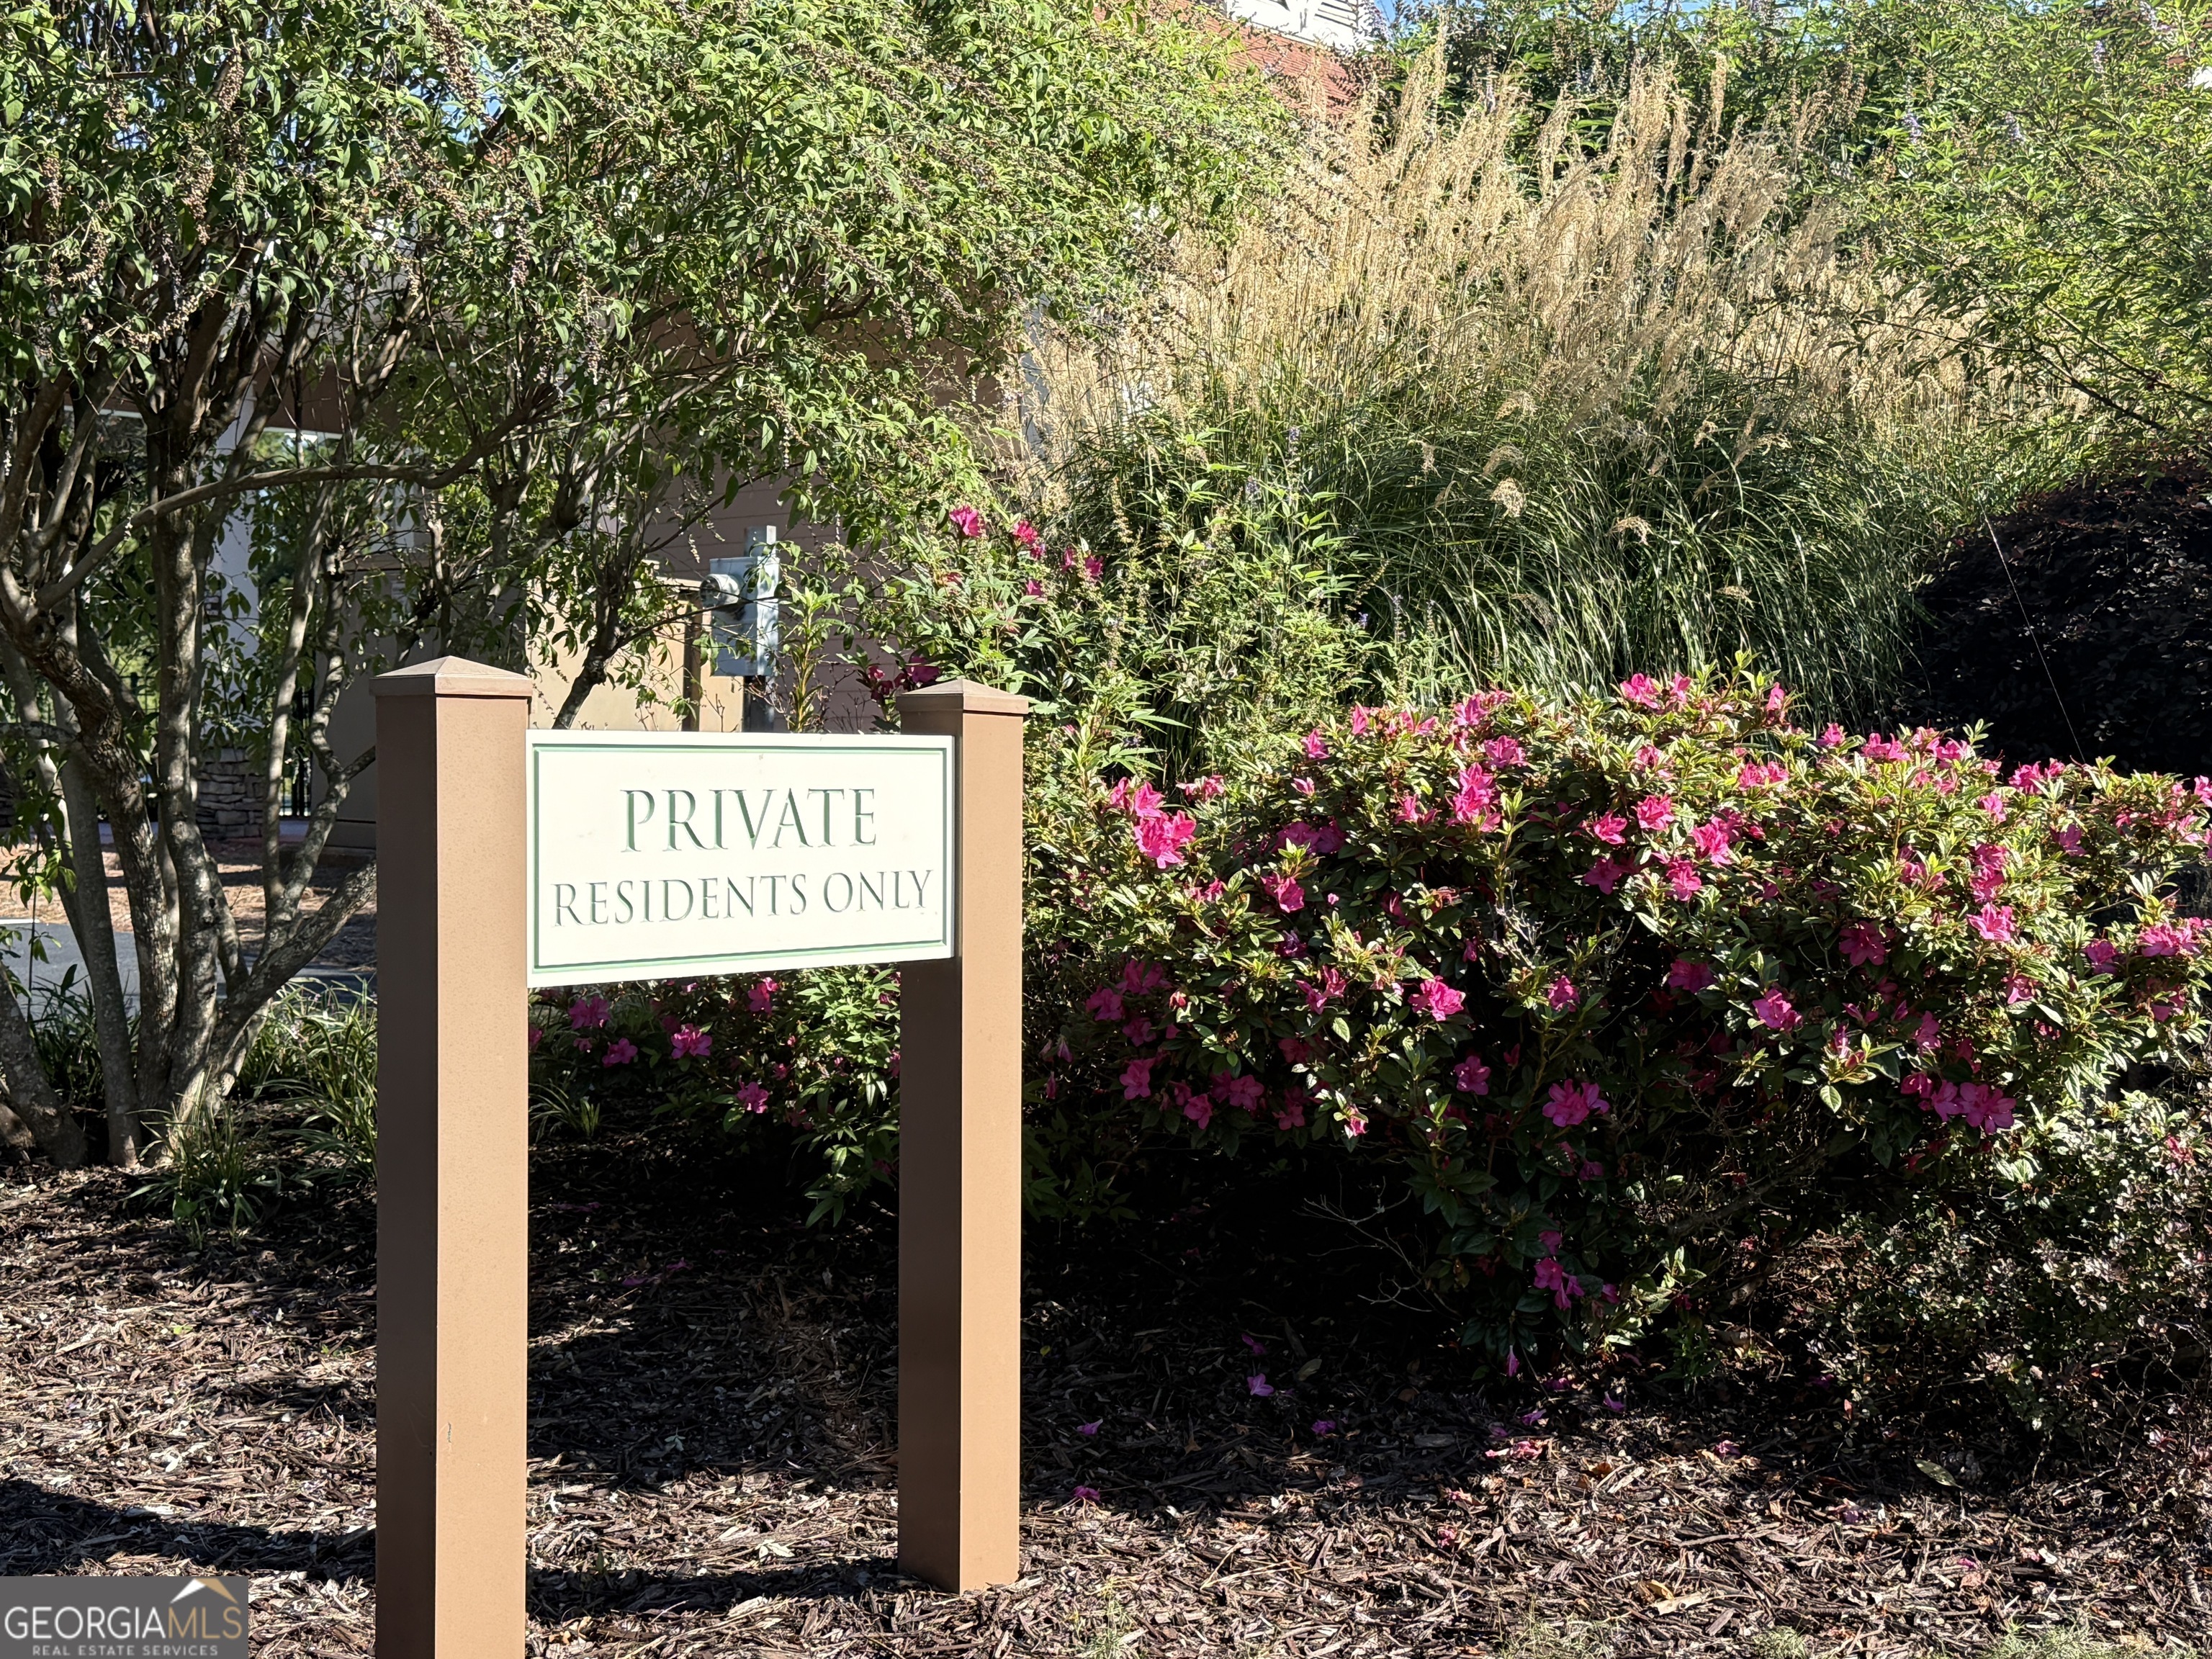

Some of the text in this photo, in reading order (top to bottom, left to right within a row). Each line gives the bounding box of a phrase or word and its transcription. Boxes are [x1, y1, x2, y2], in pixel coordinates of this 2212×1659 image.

[620, 788, 876, 853] PRIVATE
[551, 869, 934, 927] RESIDENTS ONLY
